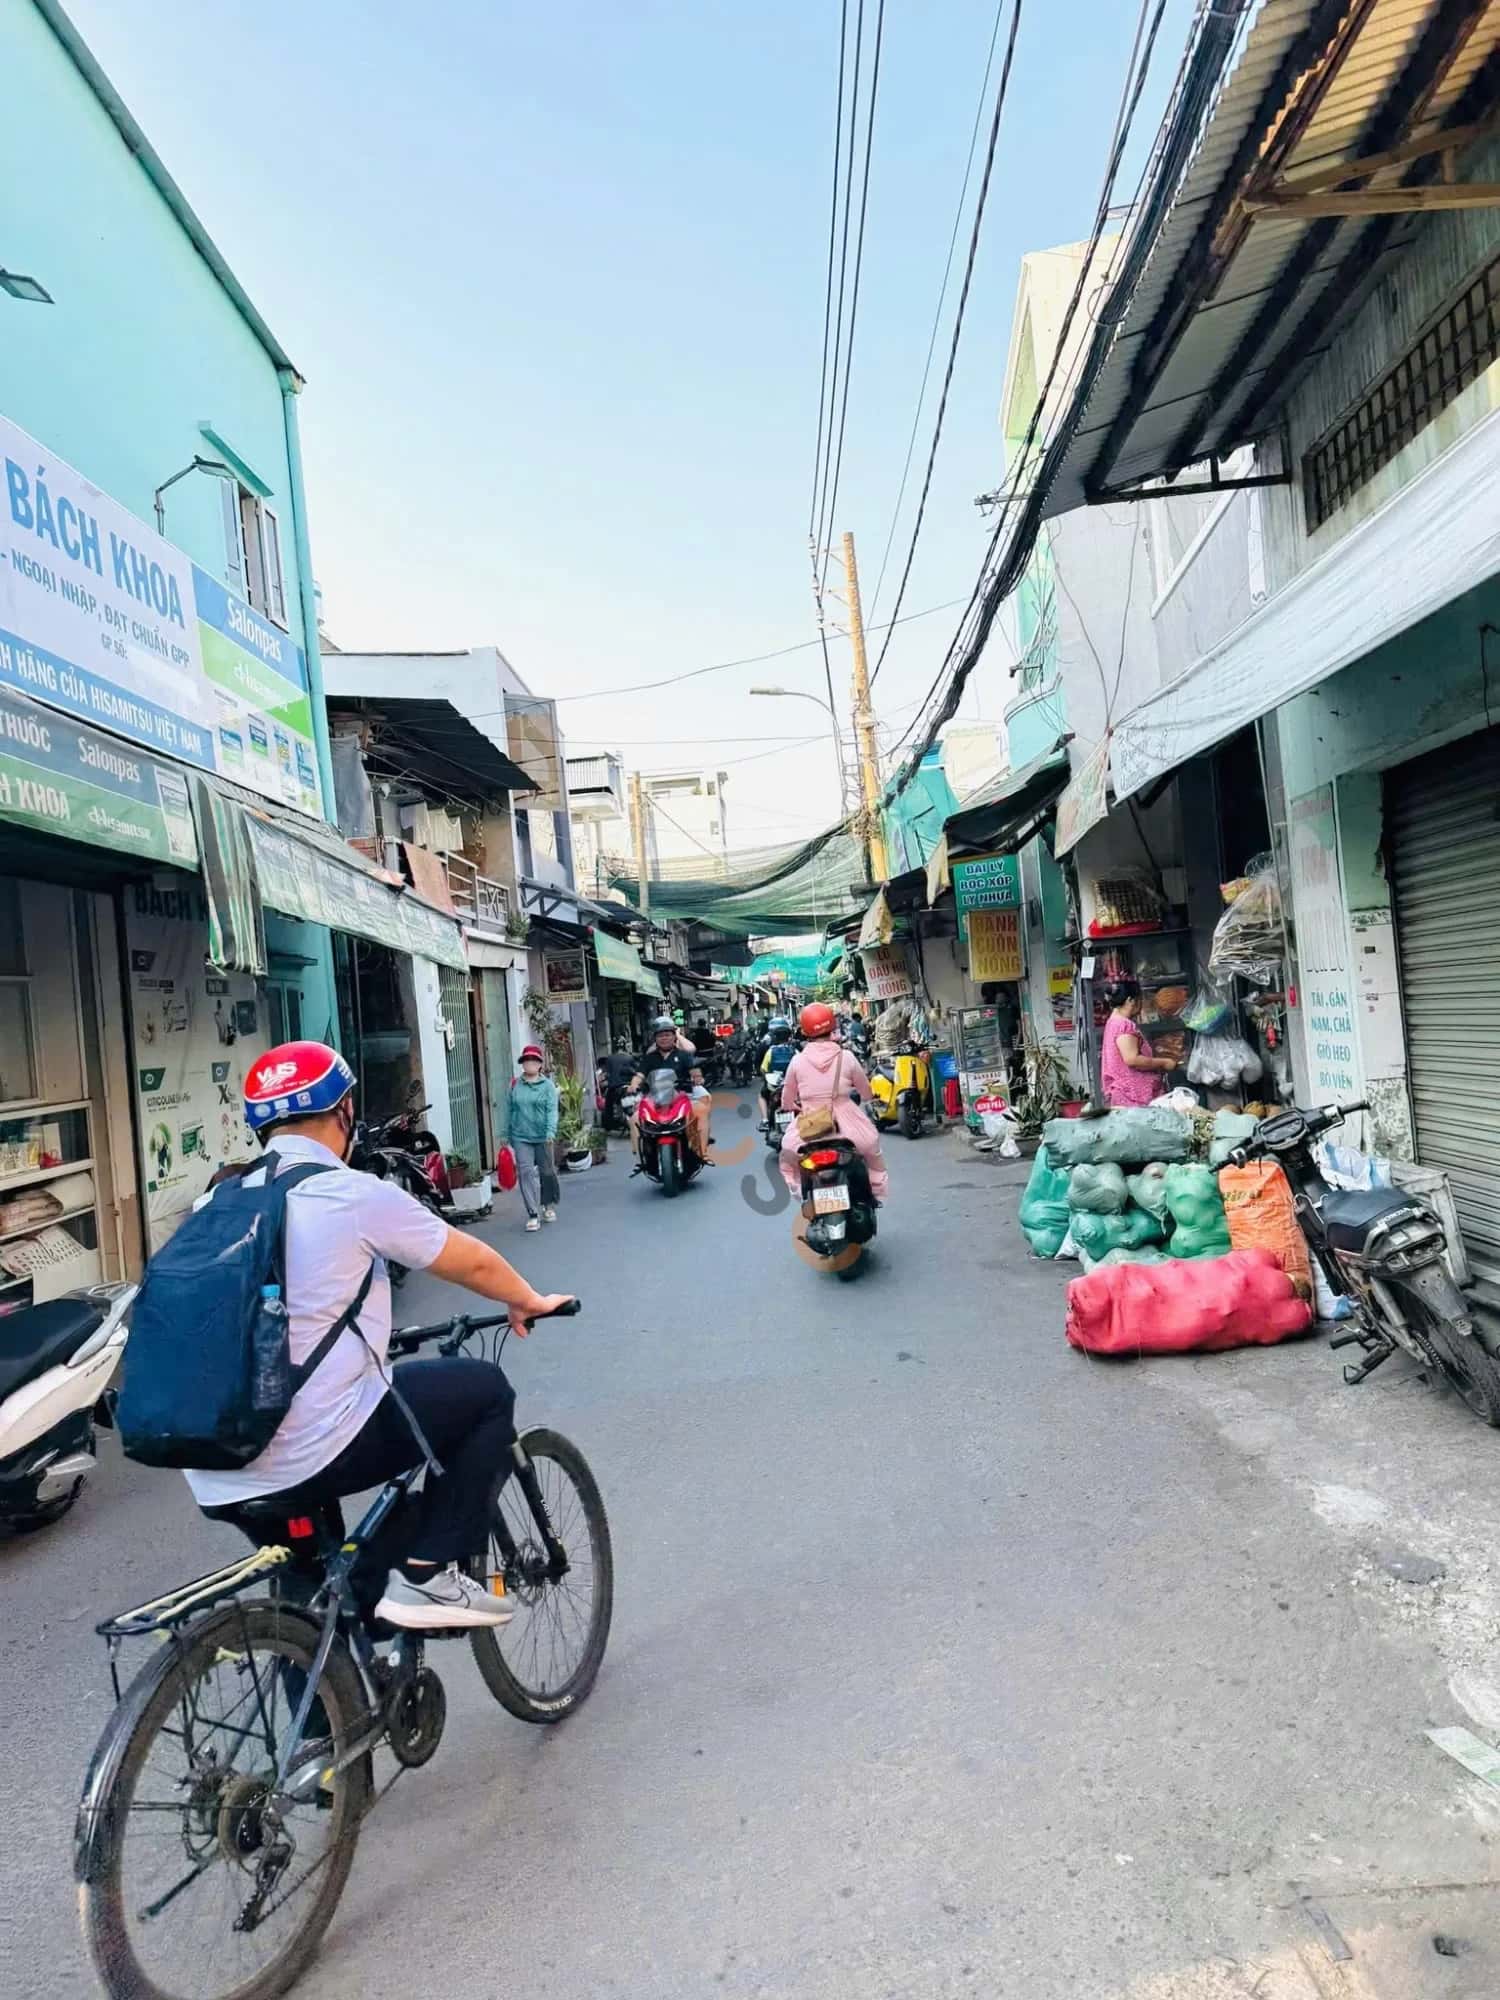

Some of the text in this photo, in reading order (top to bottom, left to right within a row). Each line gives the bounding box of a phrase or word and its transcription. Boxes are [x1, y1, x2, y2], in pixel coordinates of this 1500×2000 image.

[5, 456, 185, 630] BÁCH KHOA
[12, 549, 56, 593] NGOẠI
[105, 603, 128, 634] ĐẠT
[132, 621, 169, 657] CHUẨN
[171, 644, 190, 669] GPP
[228, 596, 282, 663] Salonpas
[60, 665, 88, 705] CỦA
[90, 684, 153, 734] HISAMITSU
[154, 714, 178, 748] VIỆT
[180, 727, 203, 757] NAM
[15, 776, 71, 821] KHOA
[78, 736, 141, 783] Salonpas
